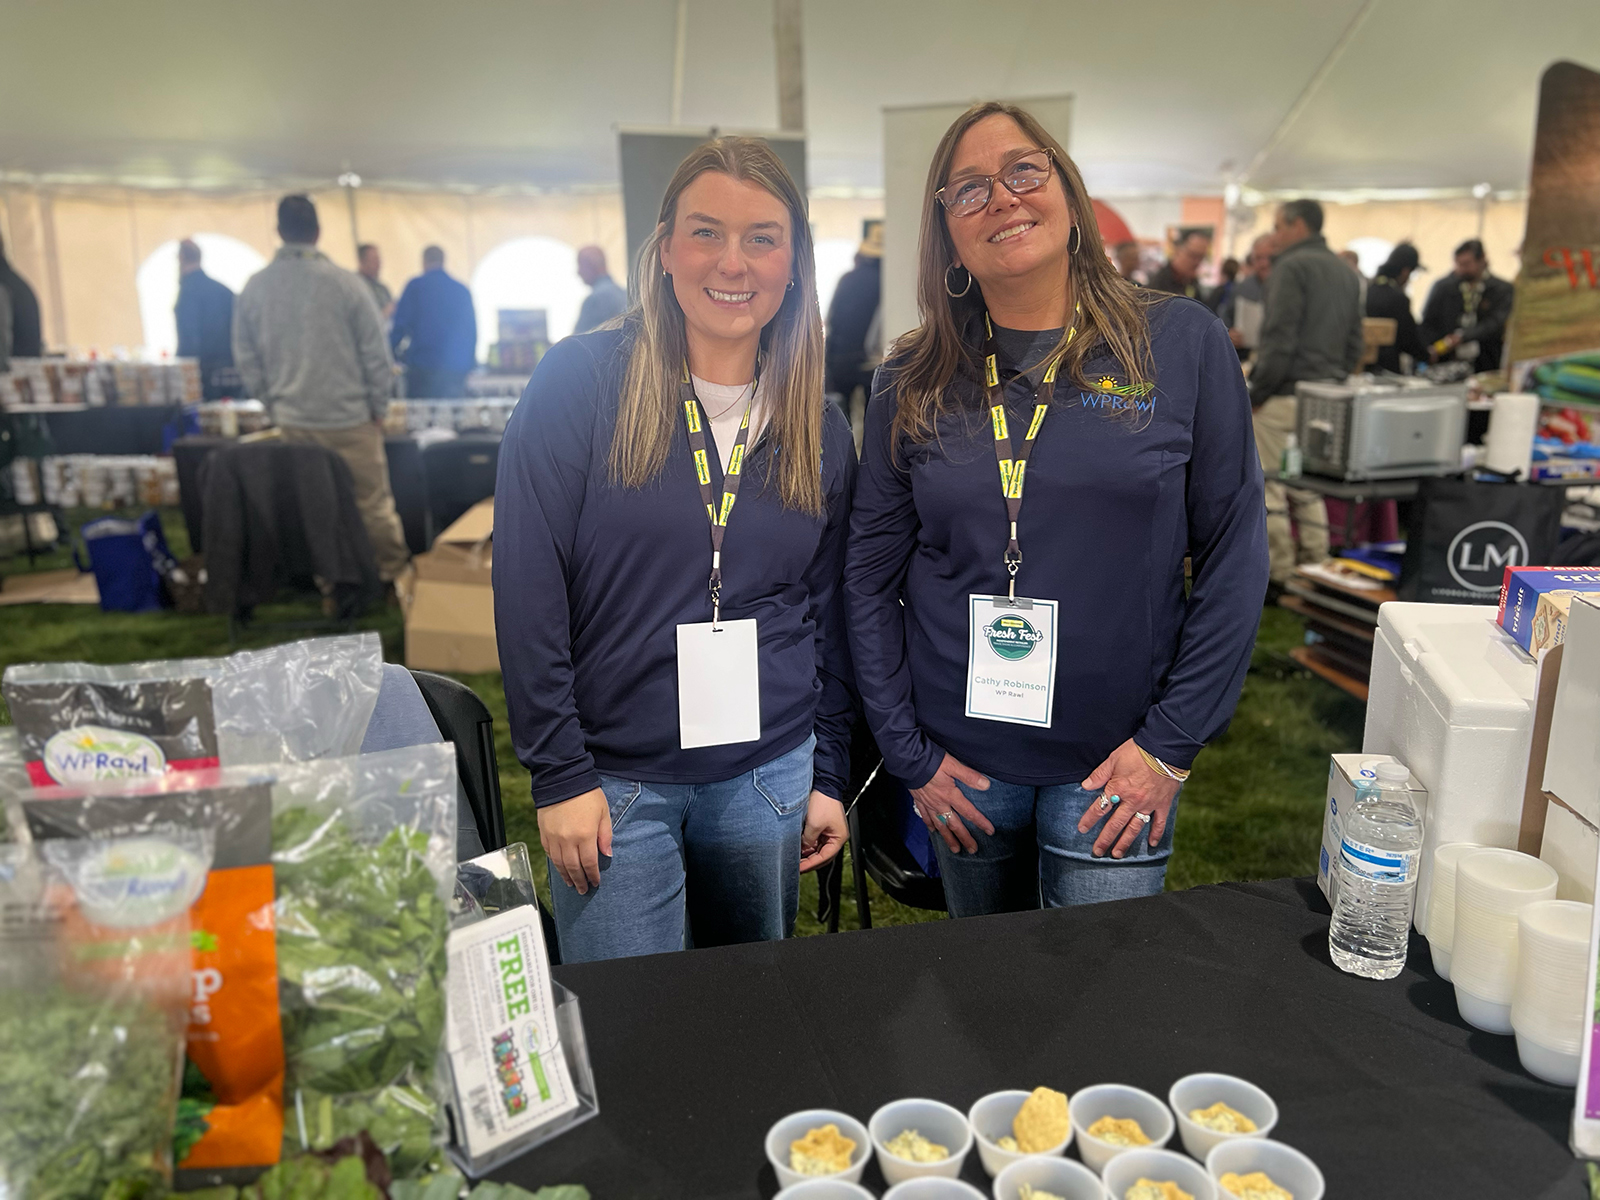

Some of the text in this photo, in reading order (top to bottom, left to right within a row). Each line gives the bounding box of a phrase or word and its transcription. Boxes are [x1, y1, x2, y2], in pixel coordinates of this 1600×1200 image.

[1459, 542, 1518, 572] LM
[1512, 587, 1524, 632] triscuit
[984, 626, 1043, 641] Fresh Fest
[975, 676, 1046, 691] Cathy Robinson
[521, 931, 533, 974] REDEEMABLE
[496, 933, 531, 1021] FREE
